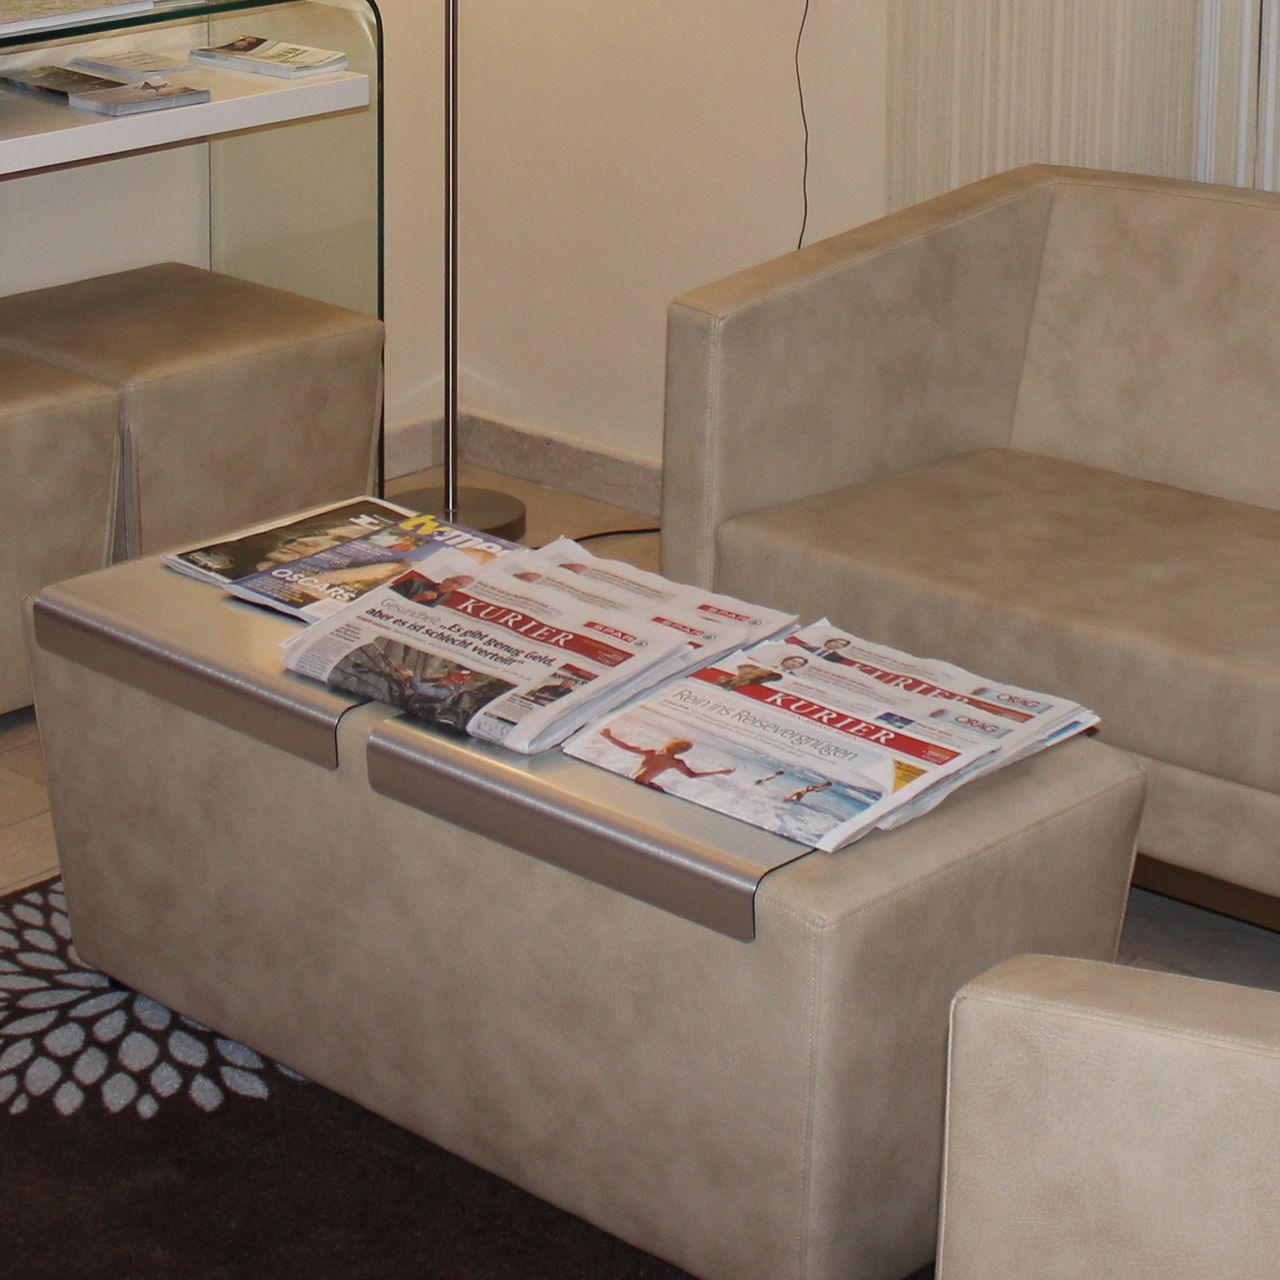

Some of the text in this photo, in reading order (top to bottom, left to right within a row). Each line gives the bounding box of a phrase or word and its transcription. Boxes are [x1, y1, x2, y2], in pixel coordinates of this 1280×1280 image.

[271, 568, 356, 602] OSCARS
[365, 607, 394, 623] aber
[392, 617, 408, 628] es
[408, 619, 424, 632] ist
[424, 625, 472, 650] schlecht
[456, 597, 575, 648] KURIER
[592, 623, 636, 643] SPAR
[662, 619, 705, 636] SPAR
[708, 607, 752, 622] SPAR
[461, 627, 489, 647] gibt
[488, 636, 525, 660] genug
[523, 650, 557, 668] Geld,
[673, 688, 858, 762] Rein ins Reisevergnügen
[764, 692, 898, 745] KURIER
